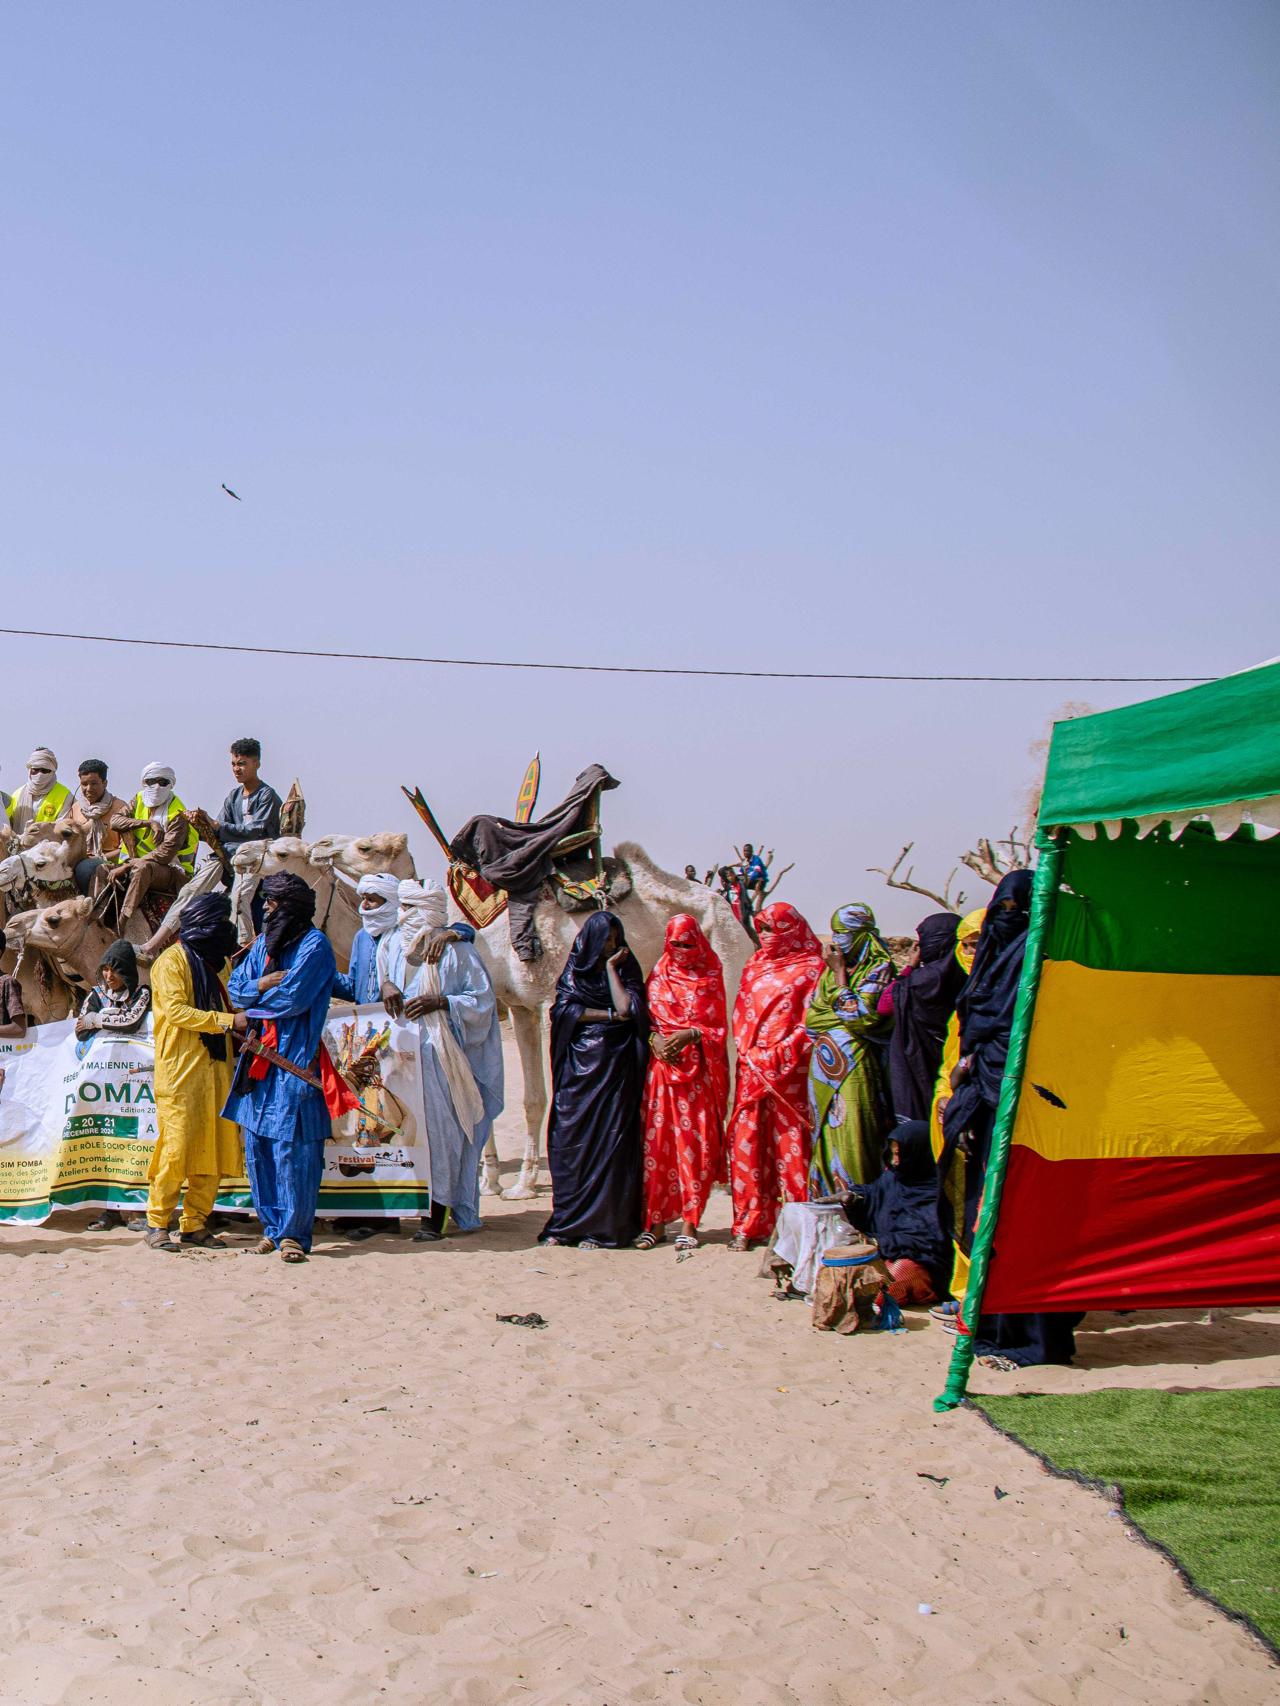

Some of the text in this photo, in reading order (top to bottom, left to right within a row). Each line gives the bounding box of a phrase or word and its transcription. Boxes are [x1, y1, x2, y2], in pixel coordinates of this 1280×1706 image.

[86, 1061, 134, 1069] MALIENNE
[64, 1082, 156, 1115] DOMA
[82, 1117, 94, 1127] 20
[104, 1117, 115, 1127] 21
[146, 1124, 155, 1133] A
[66, 1158, 76, 1166] de
[79, 1155, 124, 1164] Dromadaire
[130, 1157, 151, 1166] Conf
[338, 1155, 374, 1163] Festival
[58, 1165, 143, 1178] Ateliers de formations
[9, 1178, 33, 1186] civique
[4, 1187, 35, 1195] citoyenne
